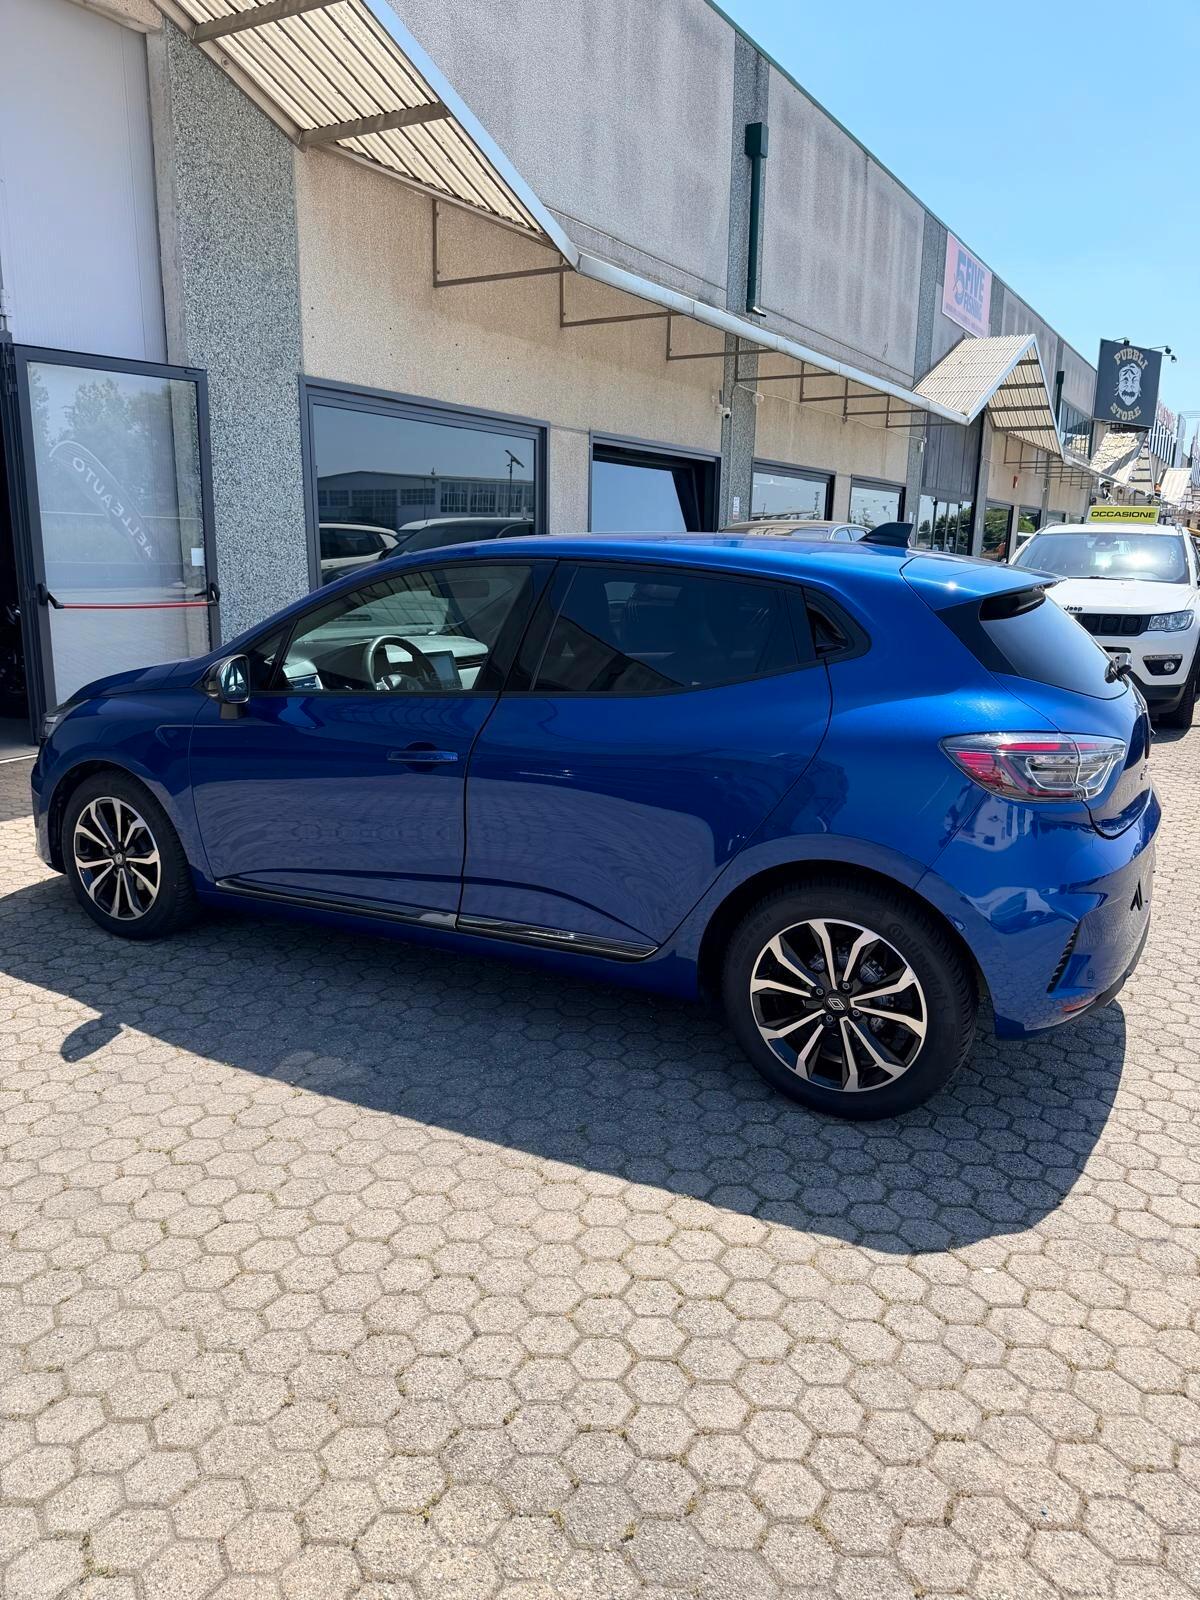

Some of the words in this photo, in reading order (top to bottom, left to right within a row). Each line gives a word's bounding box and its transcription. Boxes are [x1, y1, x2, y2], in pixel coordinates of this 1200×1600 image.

[965, 257, 984, 303] FIVE
[1114, 348, 1149, 370] PUBBLI
[1110, 403, 1142, 421] STORE
[1090, 511, 1156, 519] OCCASIONE
[1063, 605, 1083, 613] Jeep
